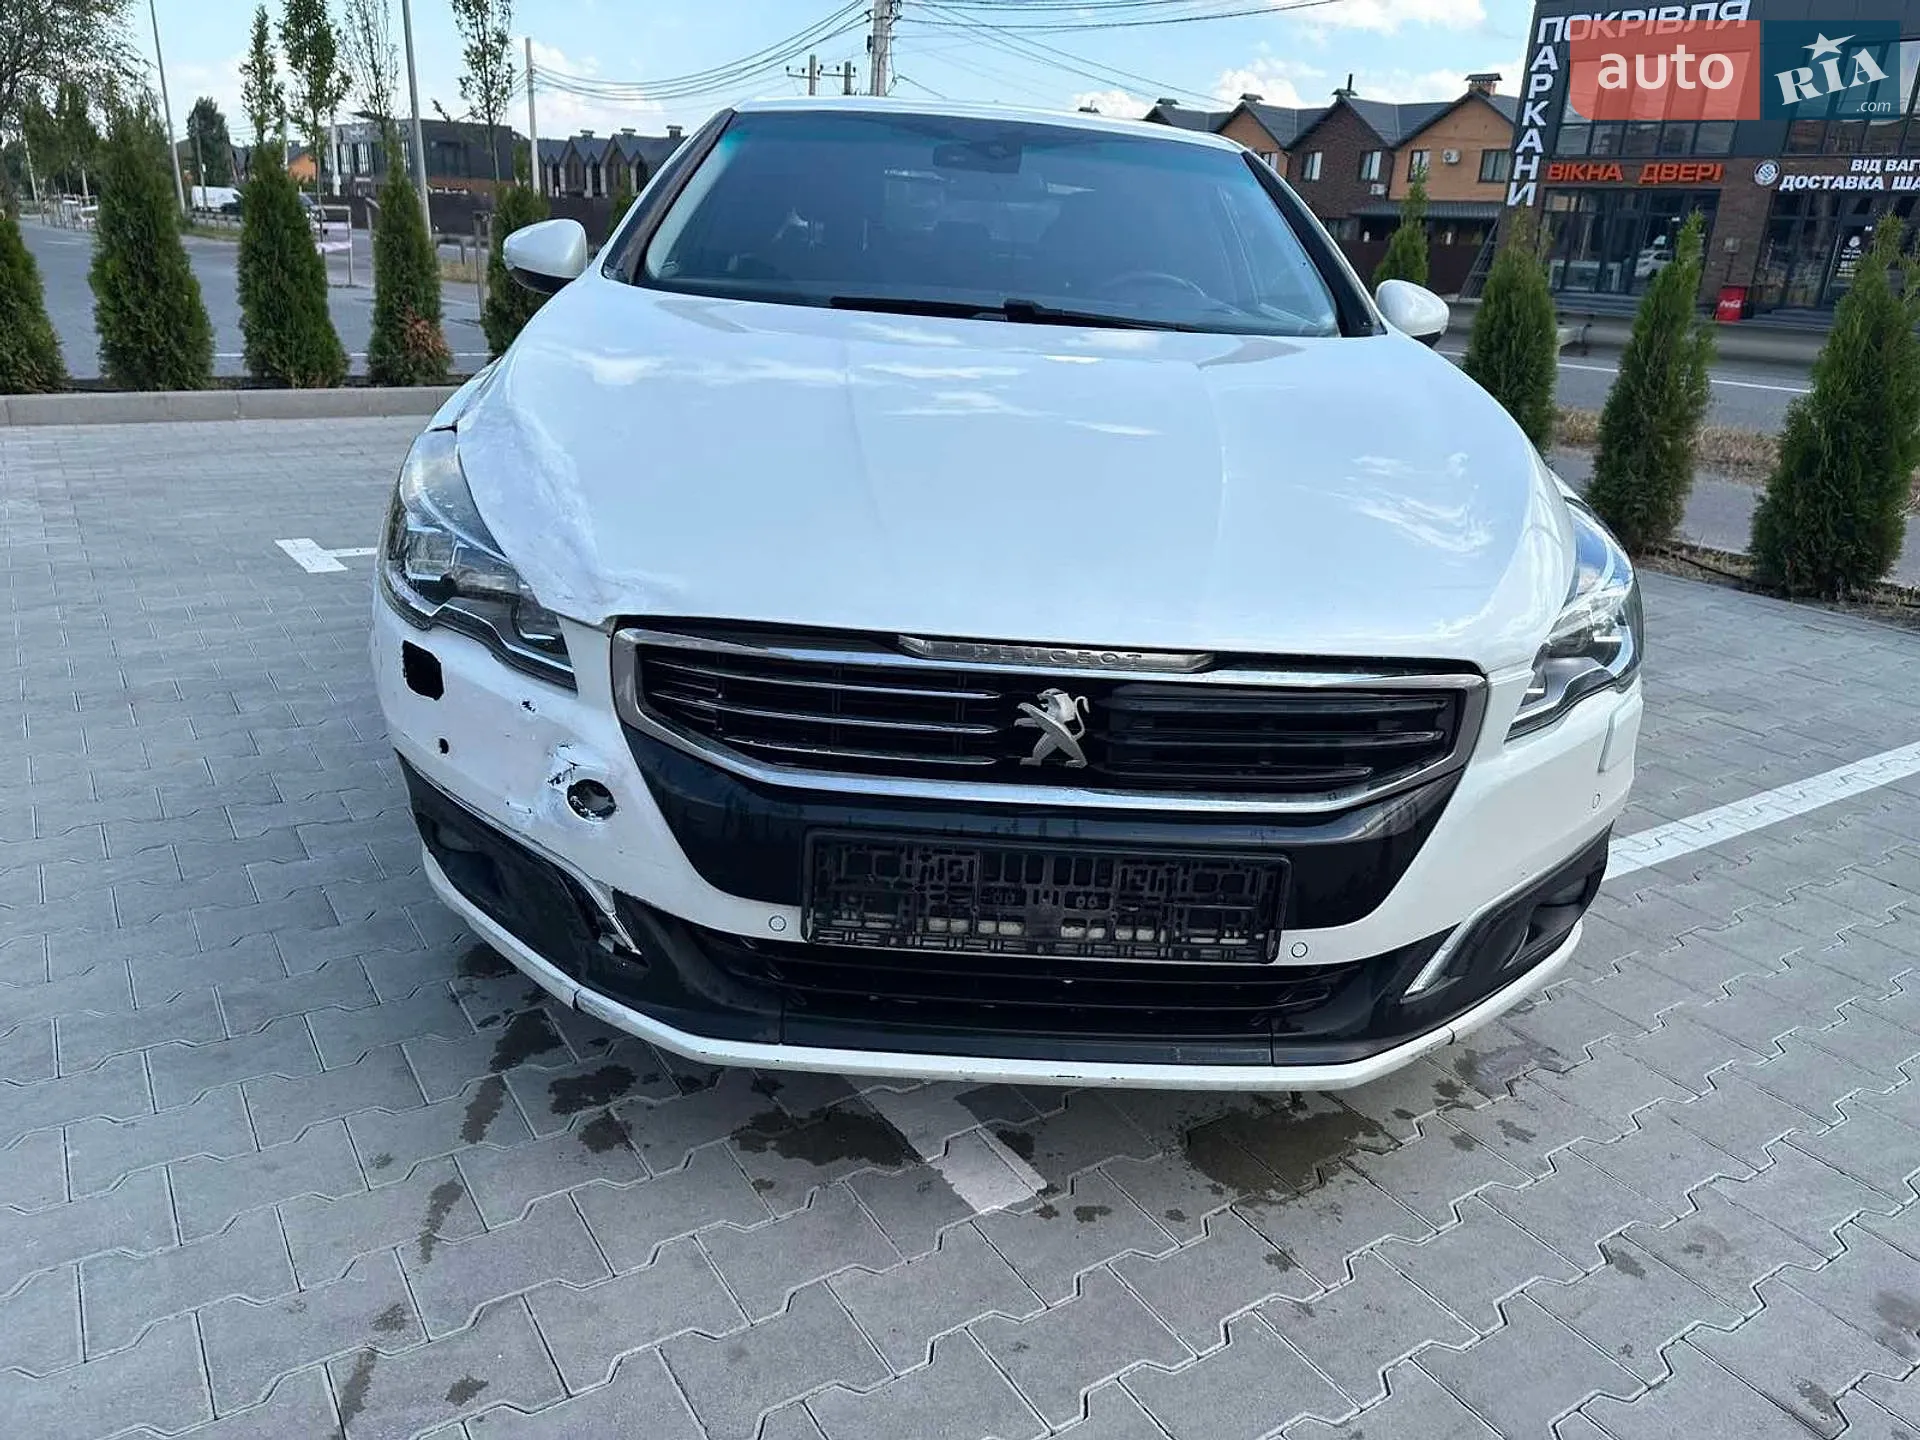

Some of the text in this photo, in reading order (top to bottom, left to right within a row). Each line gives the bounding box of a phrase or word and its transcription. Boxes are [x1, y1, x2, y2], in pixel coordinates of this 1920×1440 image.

[1537, 0, 1751, 43] ПОКРІВЛЯ
[1546, 163, 1725, 184] ВІКНА ДВЕРІ
[1850, 159, 1882, 173] ВІД
[1779, 175, 1884, 191] ДОСТАВКА
[973, 644, 1142, 665] PEUGEOT
